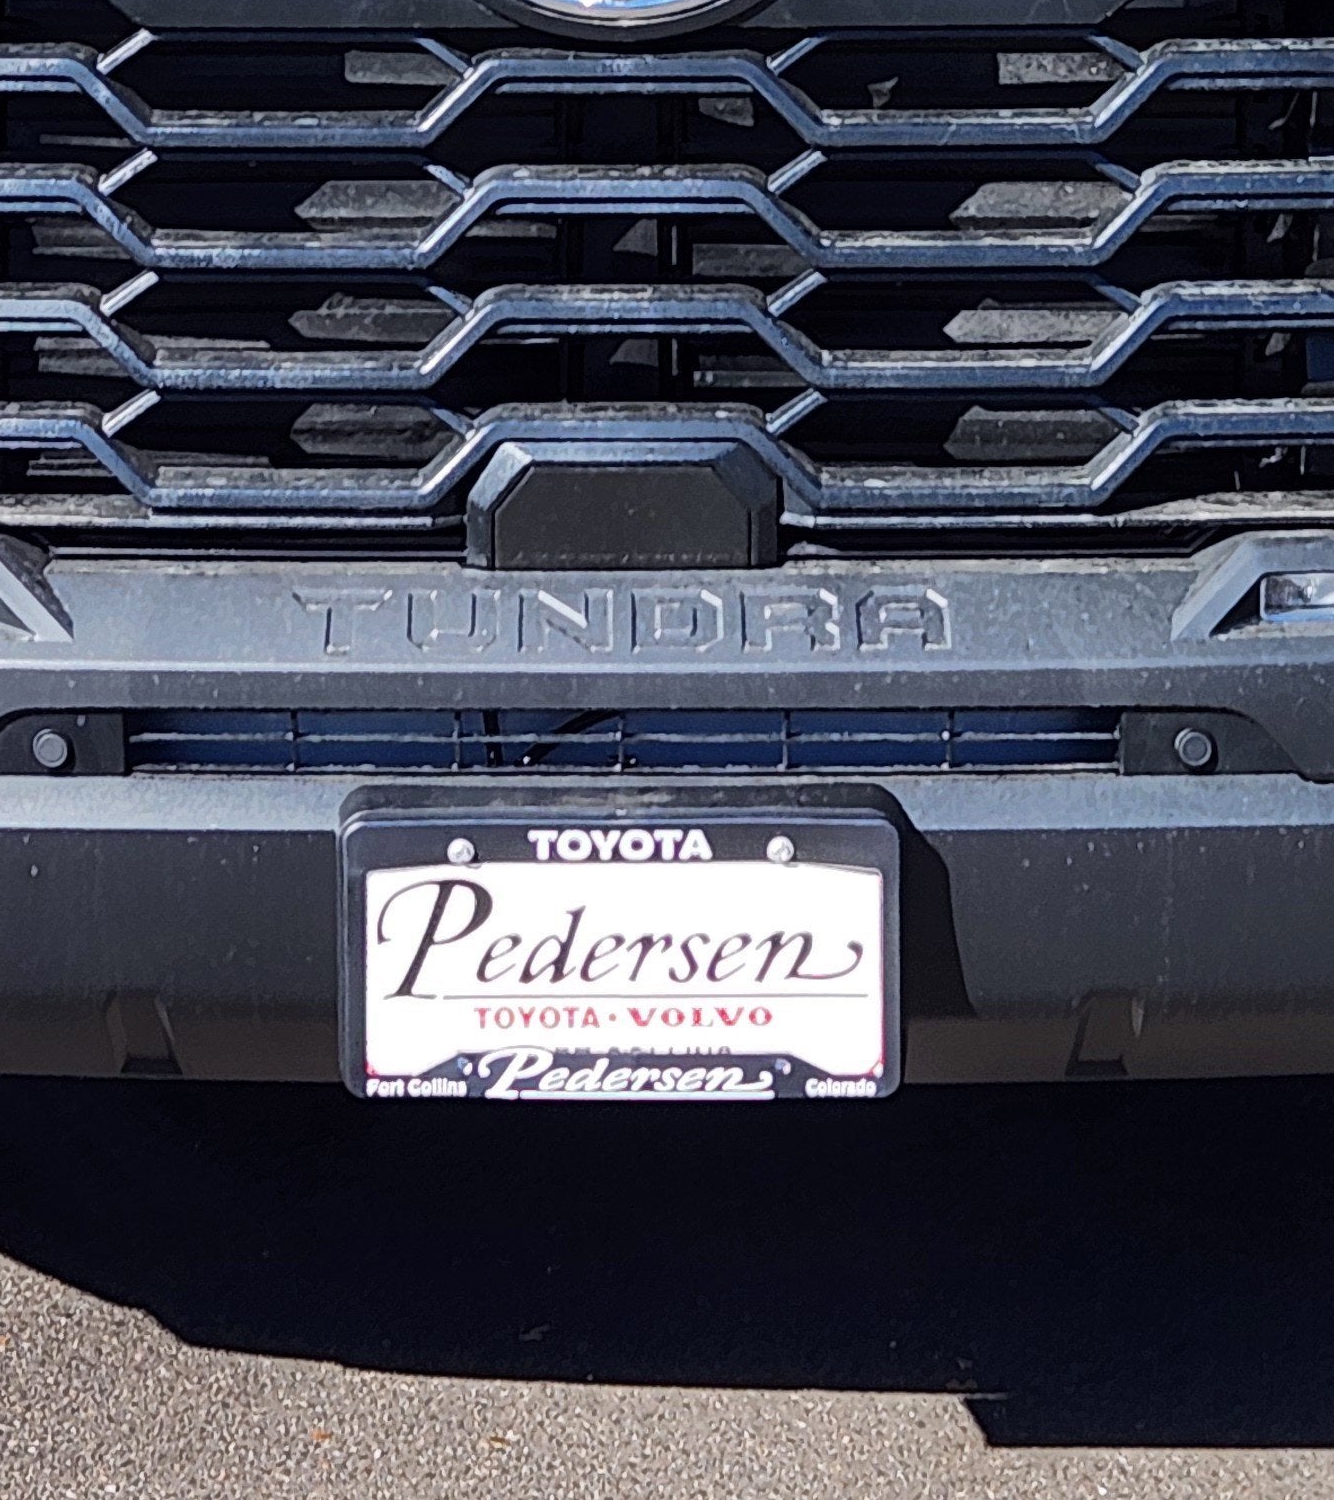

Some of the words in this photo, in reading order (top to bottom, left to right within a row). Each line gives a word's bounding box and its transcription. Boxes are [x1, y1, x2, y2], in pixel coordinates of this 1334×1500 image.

[293, 589, 952, 653] TUNDRA
[527, 829, 713, 861] TOYOTA
[376, 879, 865, 1000] Pedersen
[473, 1006, 601, 1029] TOYOTA
[627, 1007, 774, 1027] VOLVO
[407, 1077, 467, 1097] Collins
[478, 1045, 774, 1099] Pedersen
[805, 1078, 877, 1097] Colorado
